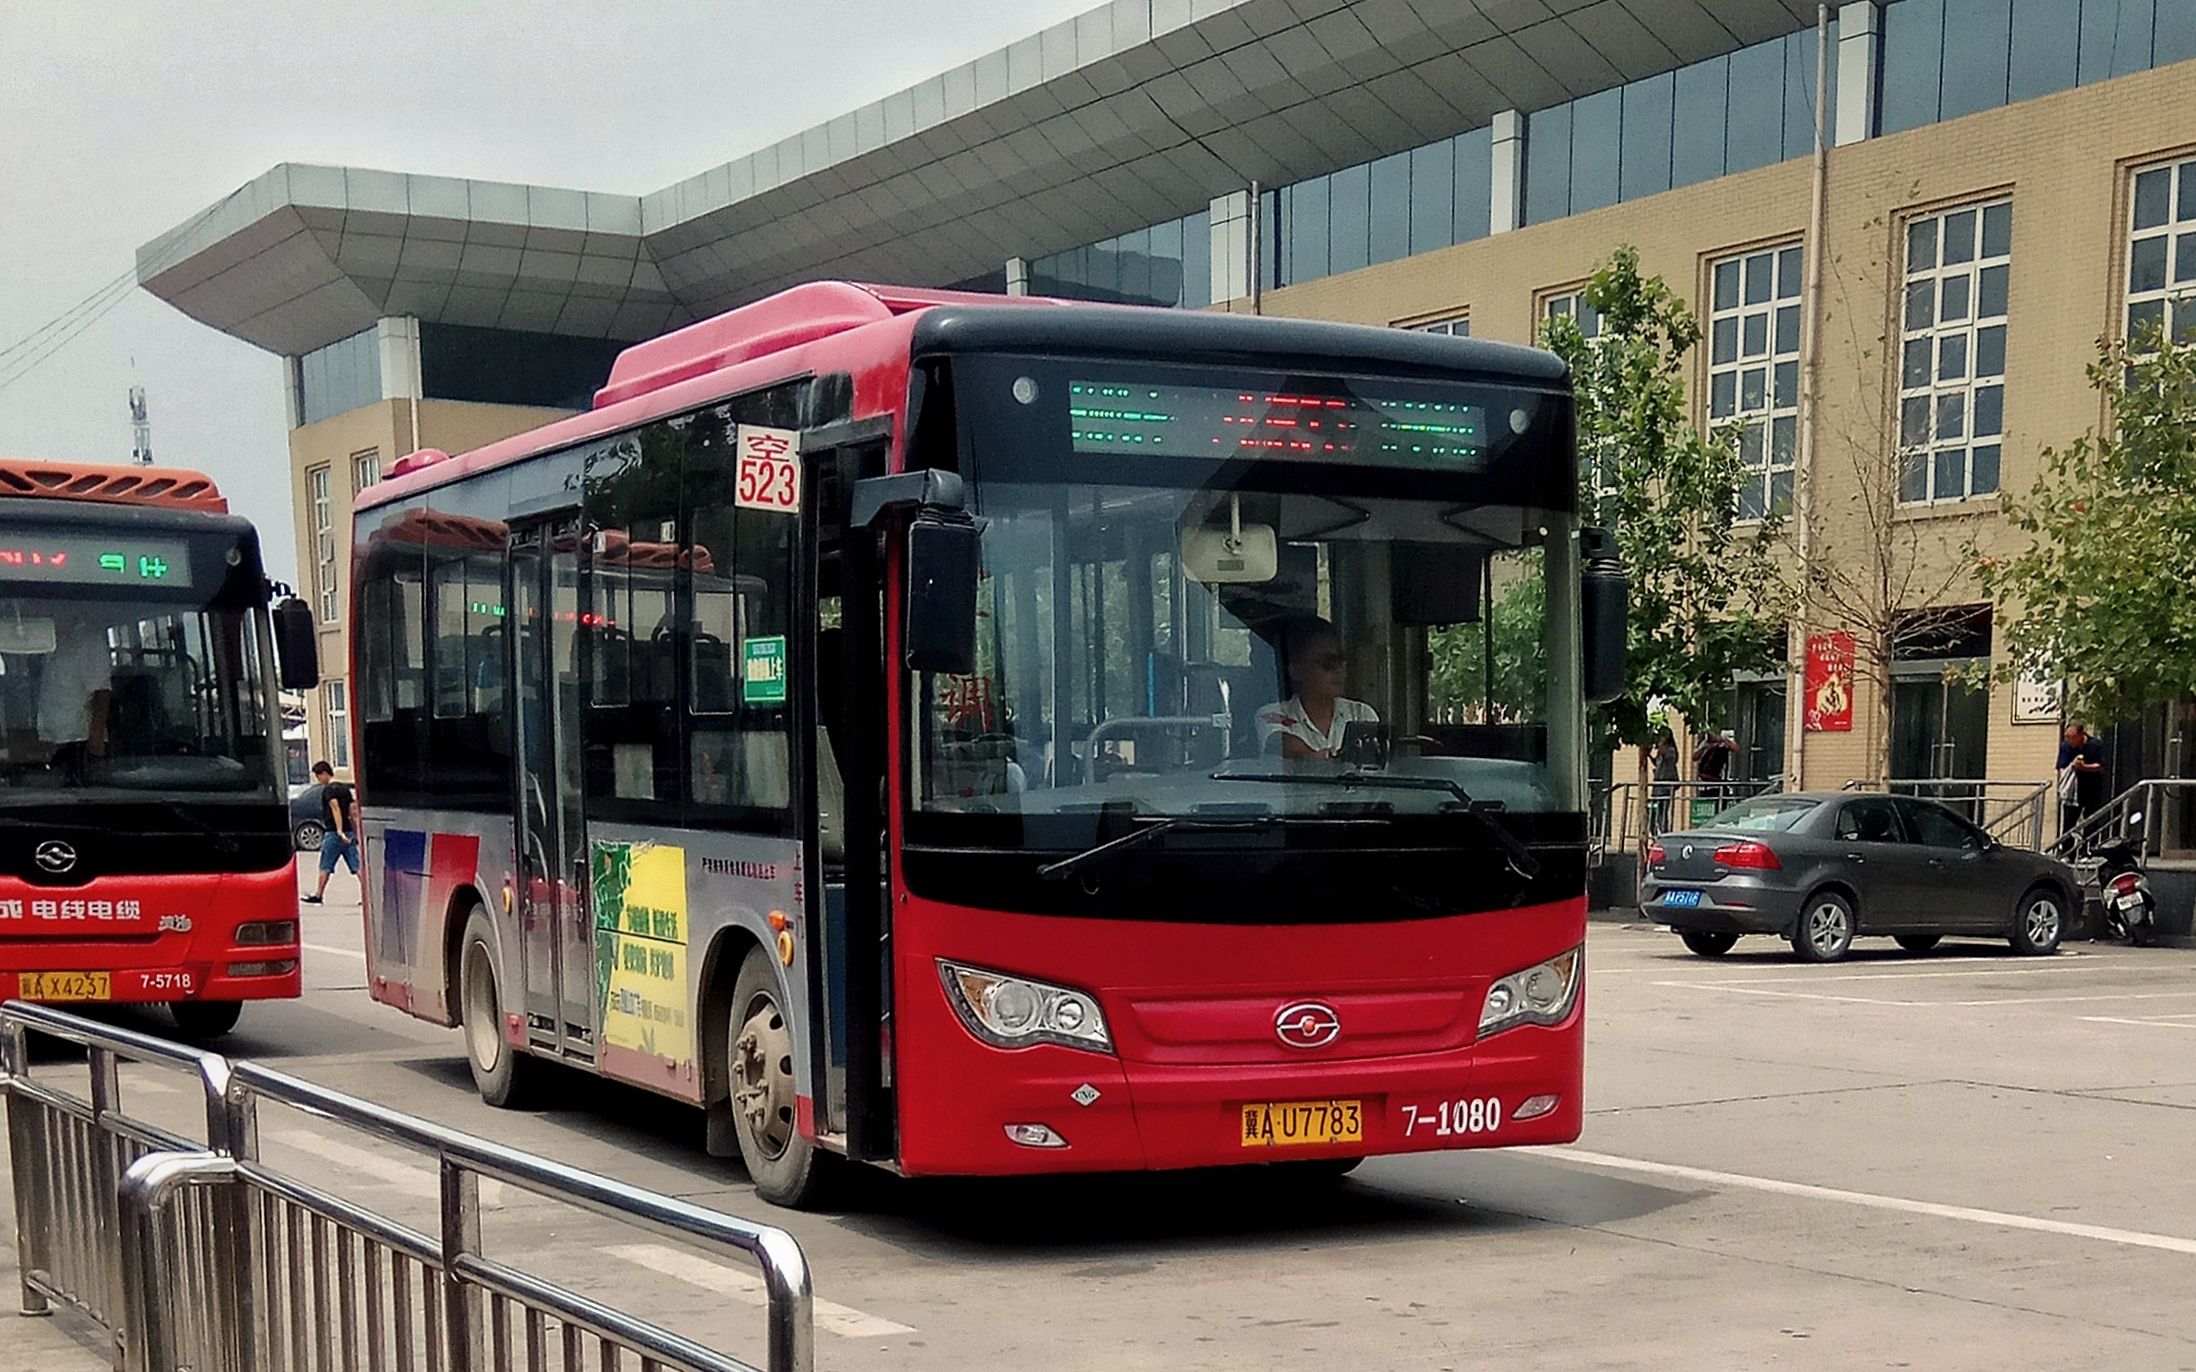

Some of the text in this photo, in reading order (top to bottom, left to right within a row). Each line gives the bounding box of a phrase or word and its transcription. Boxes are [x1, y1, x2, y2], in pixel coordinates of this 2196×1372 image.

[746, 433, 790, 462] 空
[739, 460, 795, 507] 523
[31, 900, 141, 921] 电线电缆
[140, 974, 192, 989] 7-5718
[1401, 1097, 1502, 1137] 7-1080
